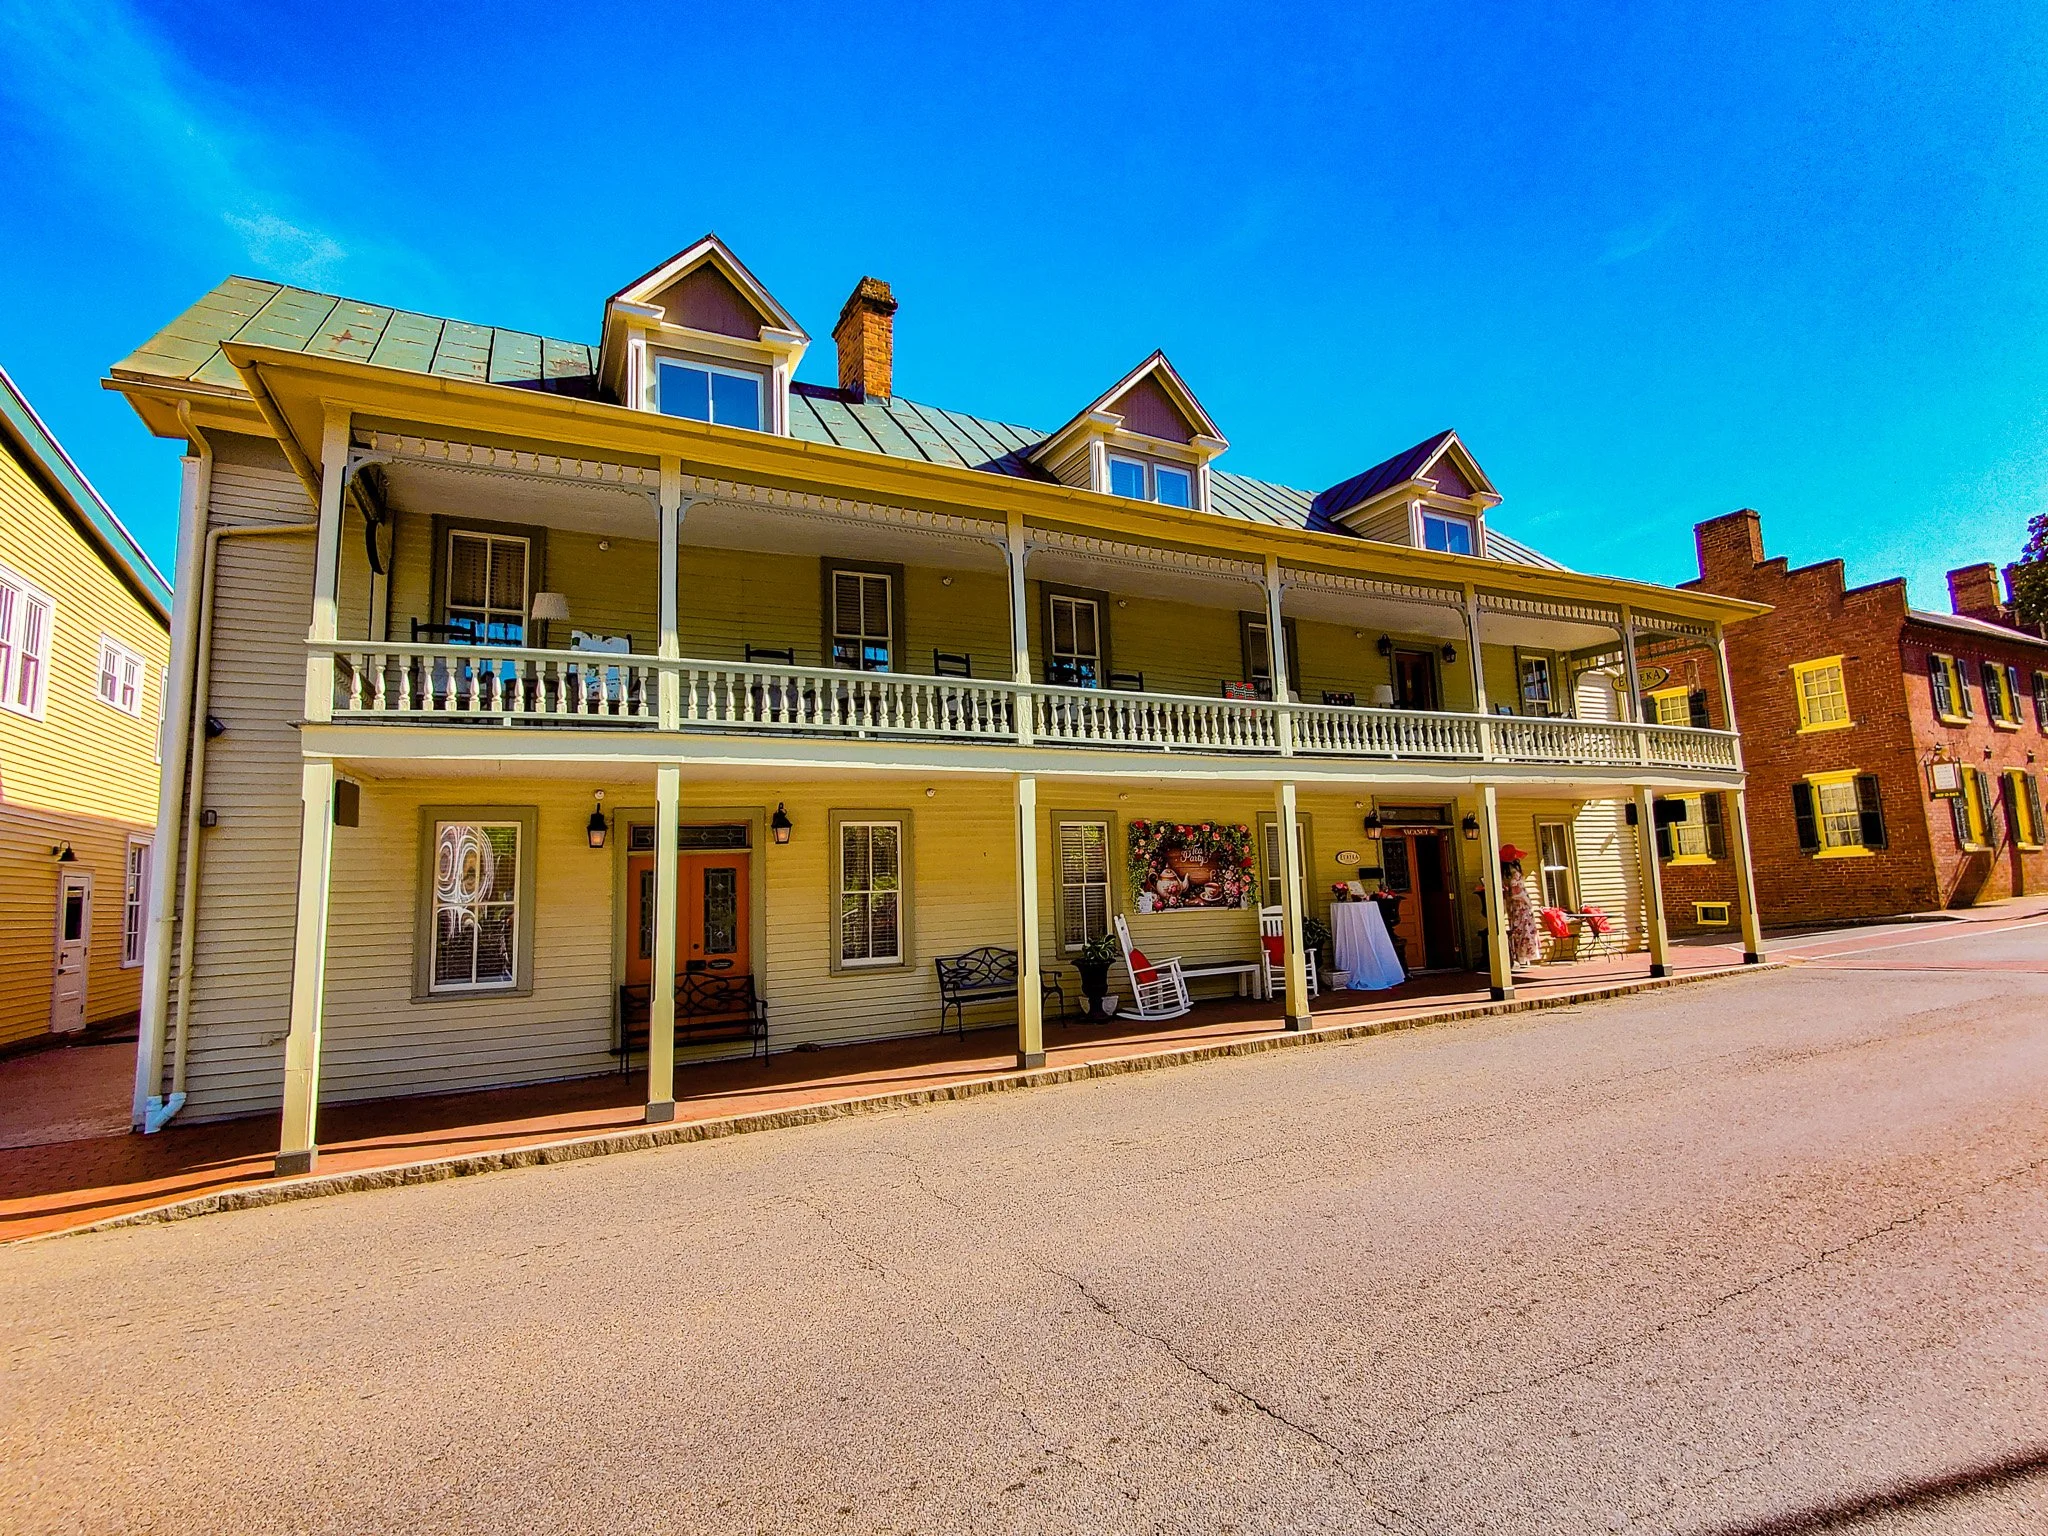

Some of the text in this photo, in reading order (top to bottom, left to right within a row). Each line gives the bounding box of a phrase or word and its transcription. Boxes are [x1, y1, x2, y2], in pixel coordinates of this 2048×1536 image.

[1618, 669, 1661, 687] EEKA
[1192, 843, 1203, 855] Tea
[1180, 850, 1208, 867] Party
